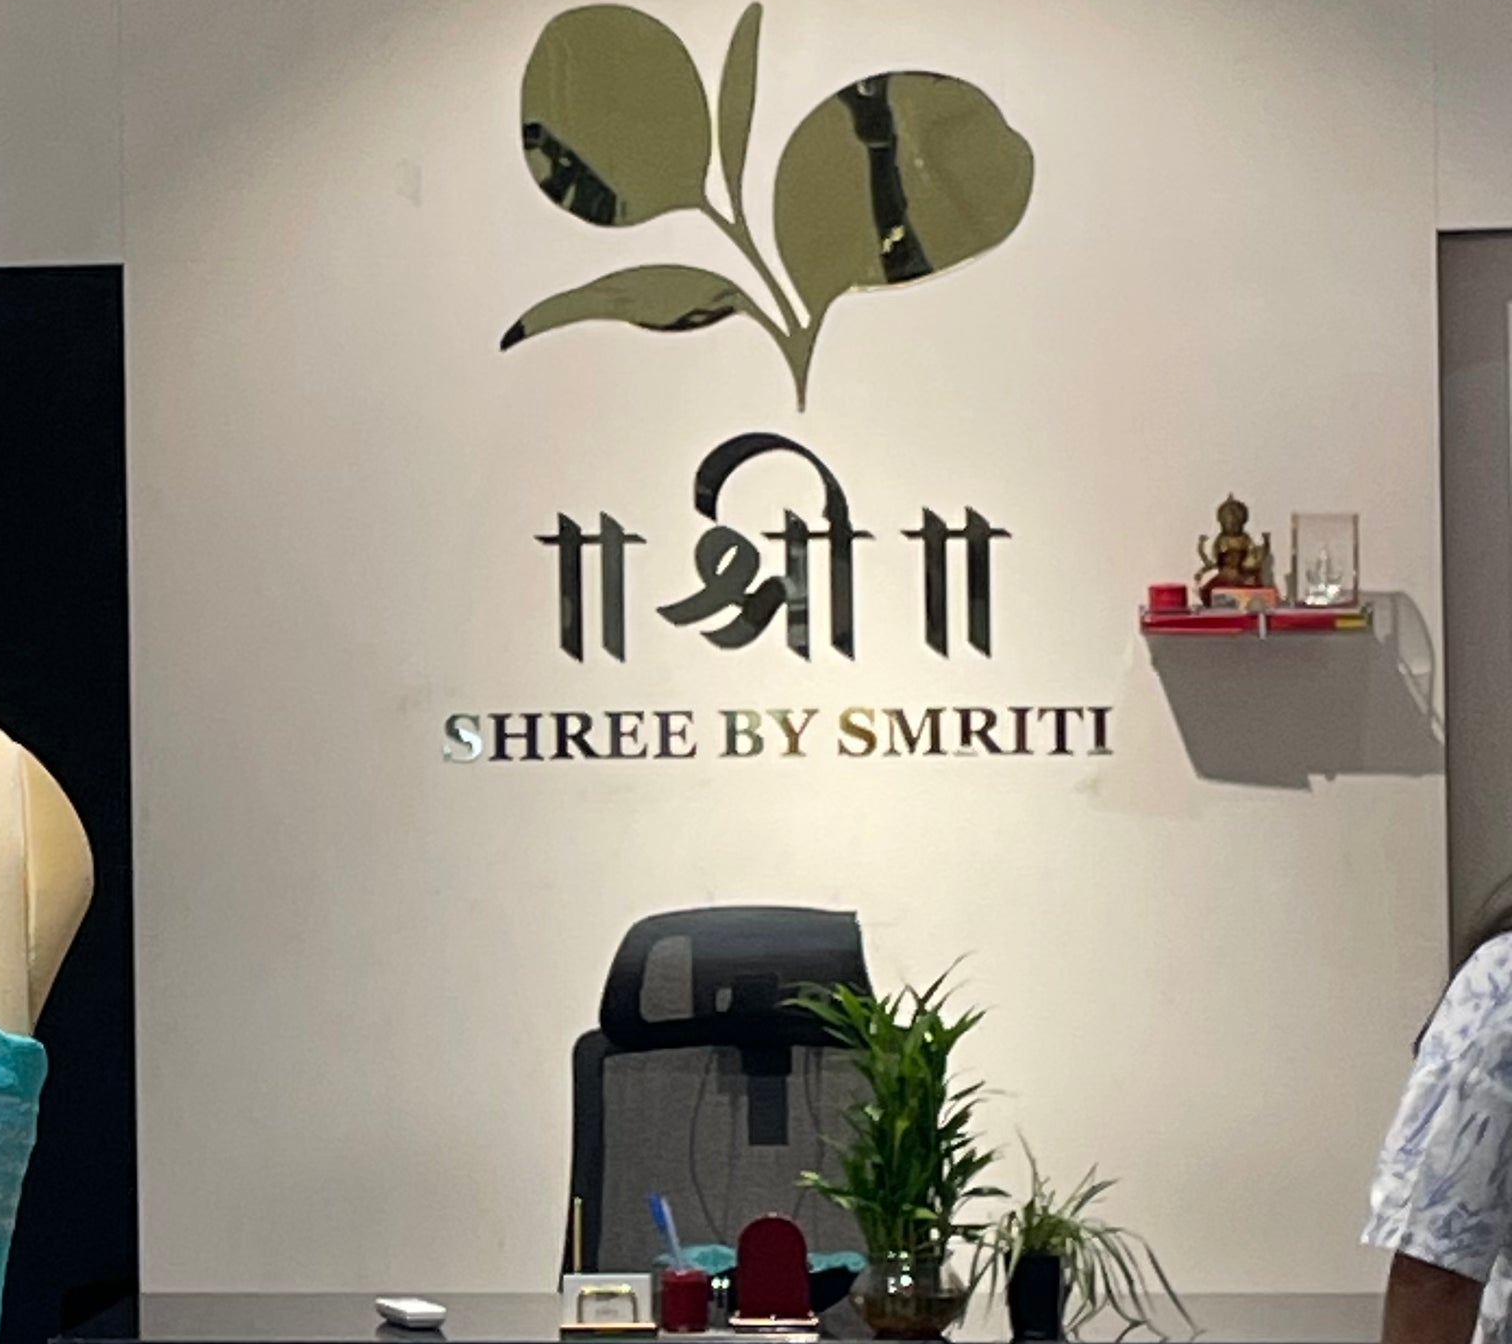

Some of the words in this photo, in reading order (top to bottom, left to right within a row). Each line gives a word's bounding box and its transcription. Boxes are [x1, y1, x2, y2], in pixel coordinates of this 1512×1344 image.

[656, 431, 875, 662] श्री
[443, 709, 698, 763] SHREE
[718, 708, 820, 758] BY
[837, 705, 1115, 757] SMRITI
